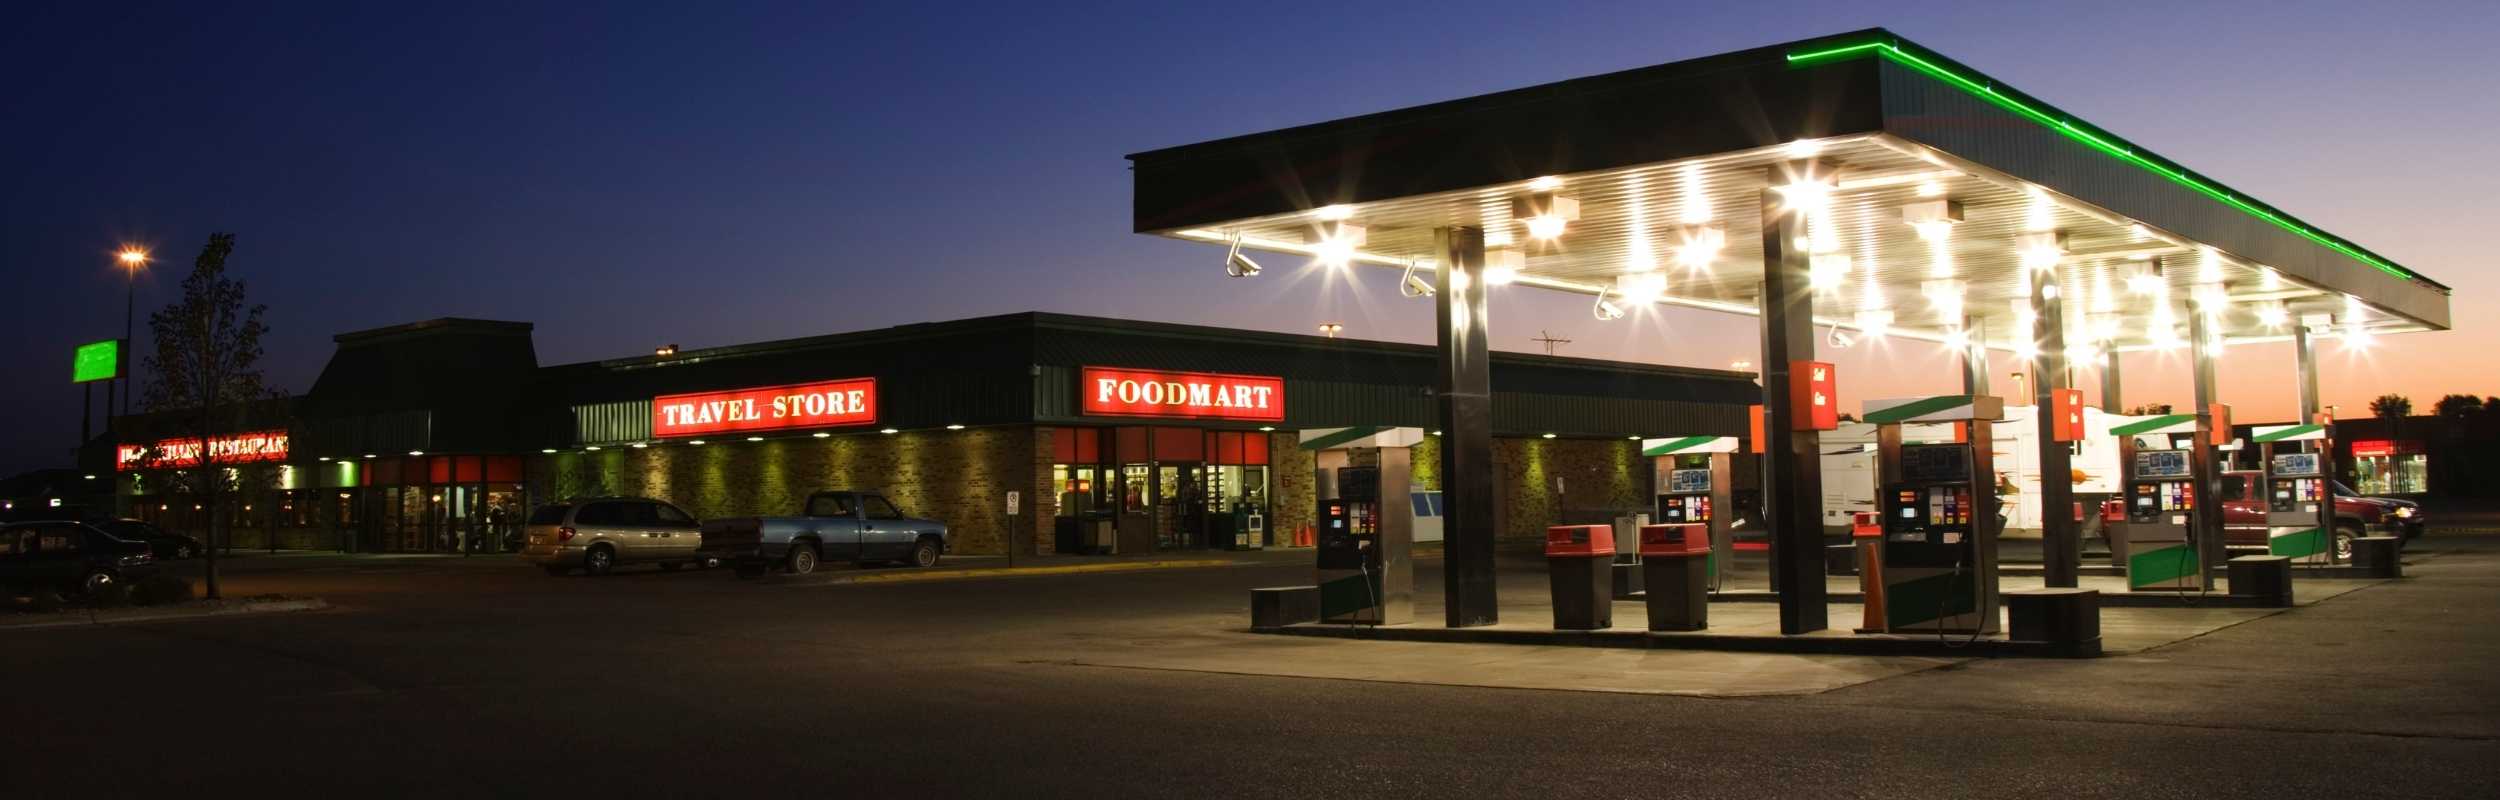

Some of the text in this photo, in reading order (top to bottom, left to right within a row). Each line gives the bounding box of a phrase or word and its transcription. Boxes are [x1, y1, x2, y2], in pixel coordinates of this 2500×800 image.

[663, 390, 866, 427] TRAVEL STORE
[1097, 378, 1272, 409] FOODMART
